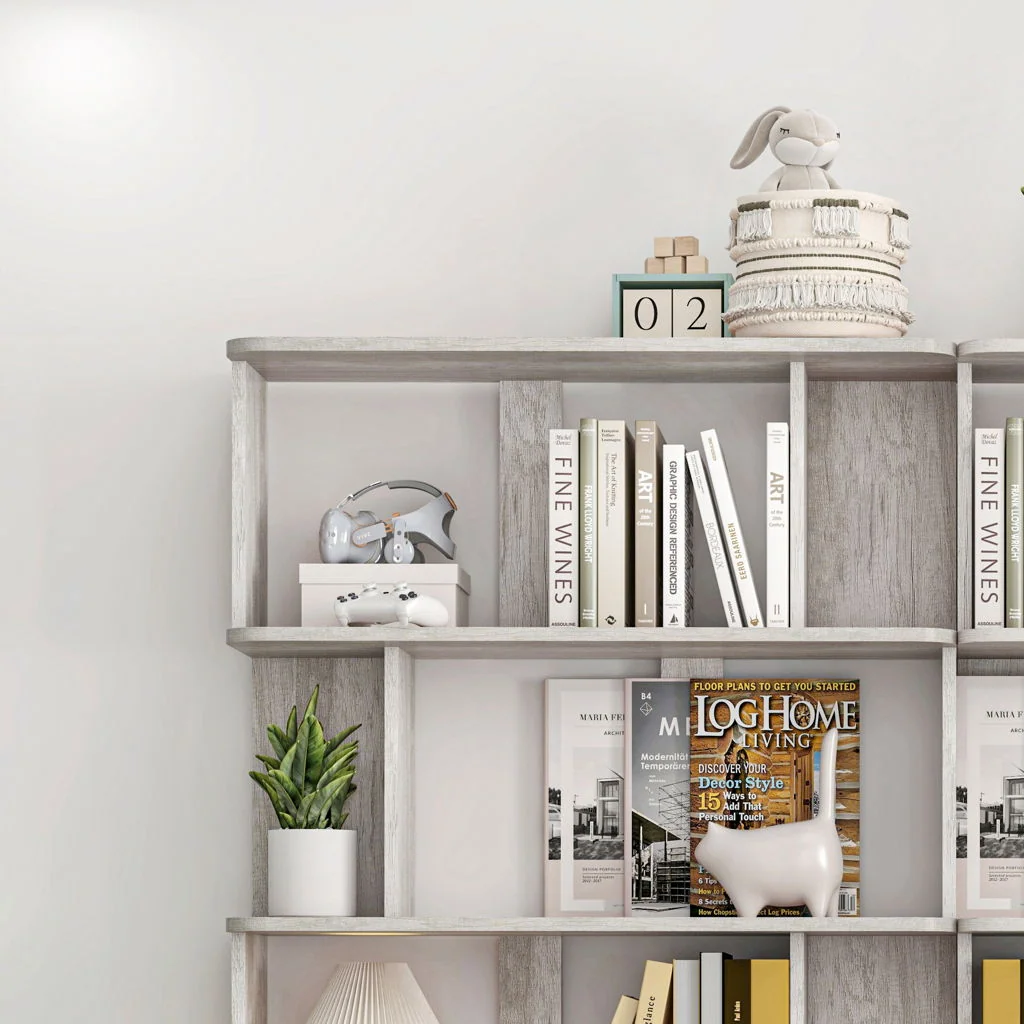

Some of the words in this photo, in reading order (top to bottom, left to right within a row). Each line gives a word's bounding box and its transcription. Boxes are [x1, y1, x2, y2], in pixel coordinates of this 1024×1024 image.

[555, 457, 572, 511] FINE
[584, 485, 593, 508] FRANK
[639, 470, 653, 503] ART
[669, 461, 677, 500] GRAPHIC
[770, 472, 784, 504] ART
[981, 457, 998, 510] FINE
[584, 510, 593, 533] LLOYD
[669, 502, 677, 535] DESIGN
[584, 534, 593, 563] WRIGHT
[706, 522, 724, 570] BORDEAUX
[728, 523, 742, 559] SAARINEN
[555, 523, 572, 604] WINES
[669, 537, 677, 595] REFERENCED
[737, 561, 747, 580] EERO
[981, 522, 998, 603] WINES
[694, 682, 723, 691] FLOOR
[726, 682, 756, 691] PLANS
[760, 682, 771, 691] TO
[774, 682, 792, 691] GET
[794, 682, 813, 691] YOU
[815, 682, 856, 691] STARTED
[742, 733, 812, 748] LIVING
[698, 776, 742, 789] Decor
[746, 776, 784, 792] Style
[698, 792, 720, 811] 15
